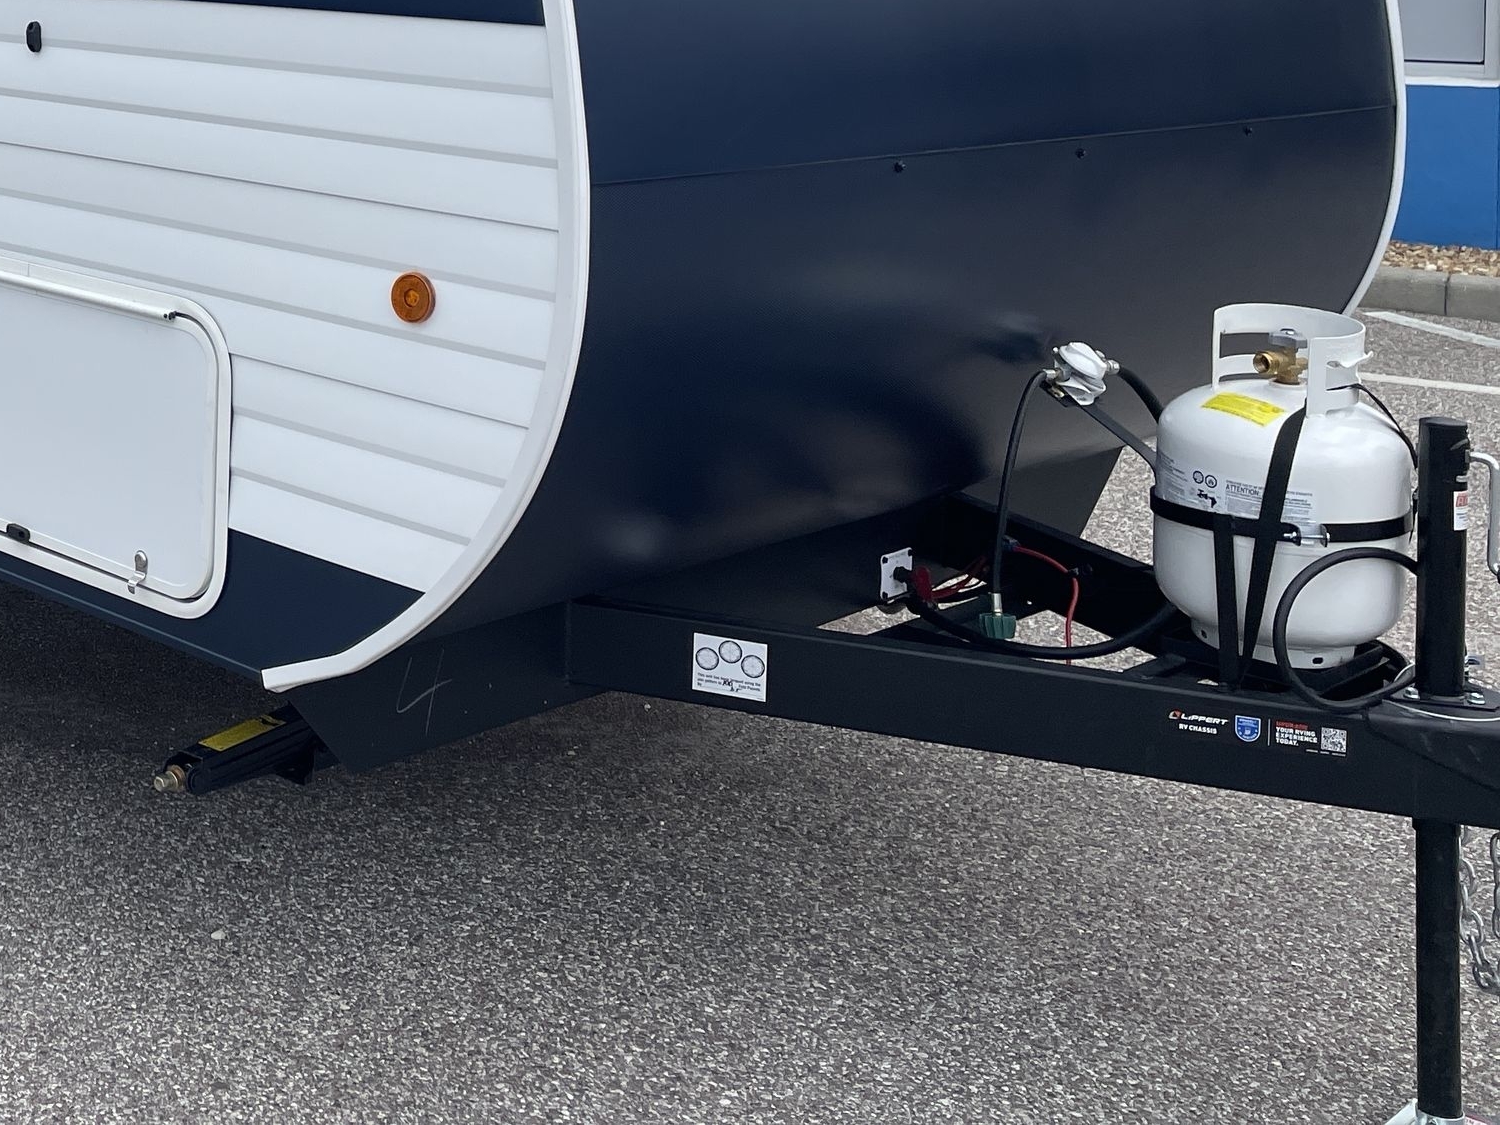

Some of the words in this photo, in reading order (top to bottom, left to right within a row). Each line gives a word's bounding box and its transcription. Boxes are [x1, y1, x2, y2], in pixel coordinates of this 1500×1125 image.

[1225, 483, 1260, 496] ATTENTION
[396, 649, 452, 736] 4
[1188, 725, 1218, 735] CHASSIS
[1275, 726, 1294, 734] YOUR
[1295, 729, 1316, 737] RVING
[1275, 732, 1318, 743] EXPERIENCE
